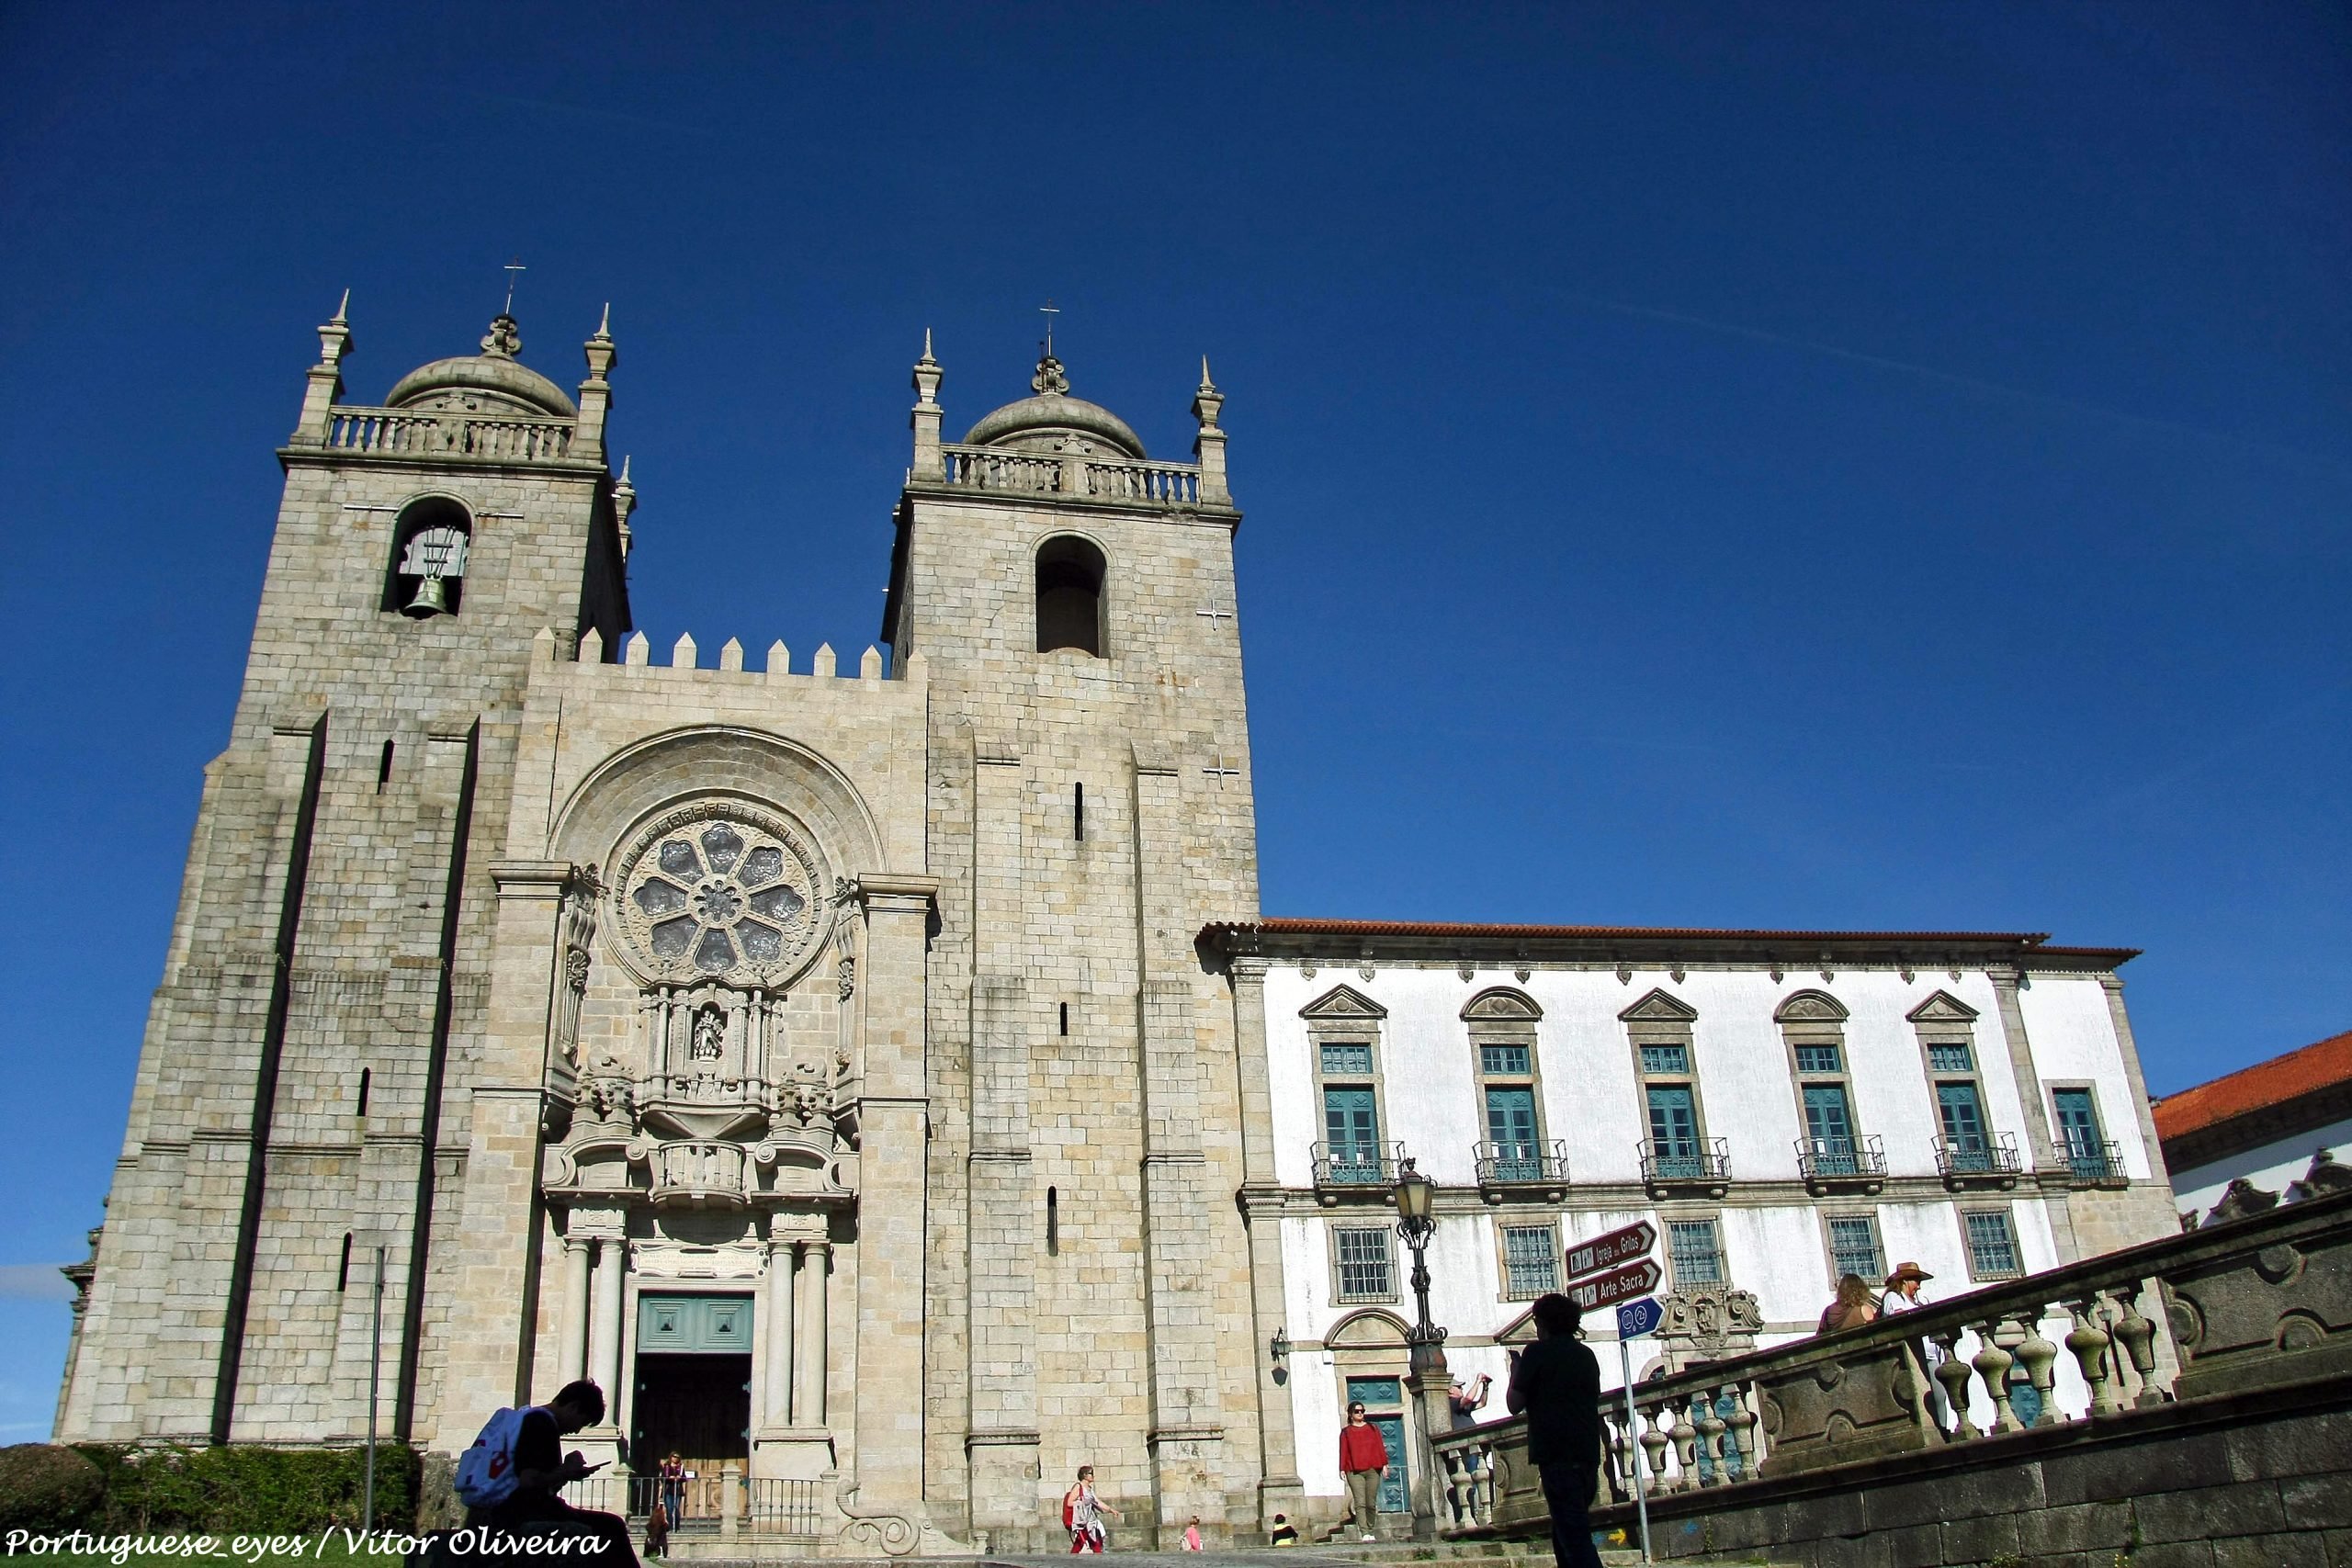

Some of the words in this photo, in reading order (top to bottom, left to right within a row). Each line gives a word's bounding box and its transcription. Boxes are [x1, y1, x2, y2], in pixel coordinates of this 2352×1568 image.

[1596, 1243, 1612, 1265] Igreja
[1620, 1235, 1639, 1254] Grilos
[1600, 1280, 1617, 1299] Arte
[1620, 1274, 1644, 1292] Sacra
